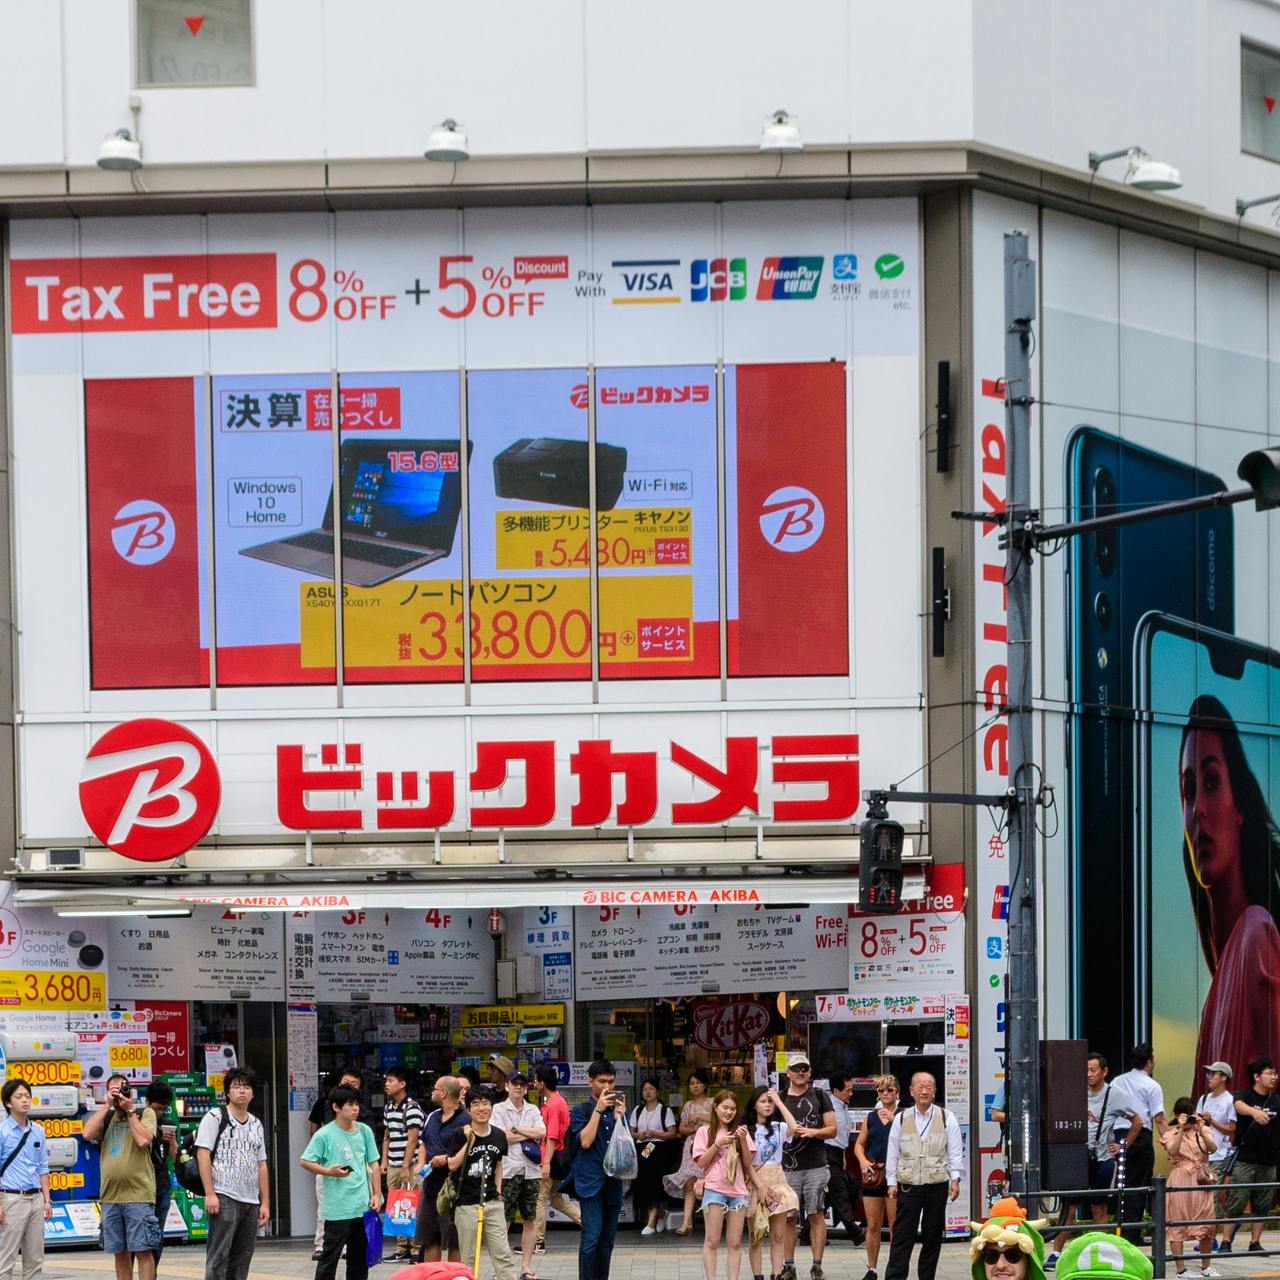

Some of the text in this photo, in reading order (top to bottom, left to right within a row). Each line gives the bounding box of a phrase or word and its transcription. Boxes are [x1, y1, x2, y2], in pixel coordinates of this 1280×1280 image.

[515, 261, 567, 276] Discount
[762, 264, 821, 282] UnionPay
[577, 269, 604, 286] Pay
[622, 271, 674, 293] VISA
[691, 270, 748, 290] JCB
[24, 272, 262, 322] Tax Free
[288, 259, 327, 323] 8
[332, 294, 398, 322] OFF
[437, 256, 476, 319] 5
[480, 291, 545, 318] OFF
[574, 283, 607, 299] With
[599, 384, 711, 406] ビックカメラ
[225, 392, 303, 429] 決算
[387, 450, 459, 473] 15.6型
[233, 481, 297, 494] Windows
[628, 479, 667, 493] Wi-Fi
[256, 496, 276, 510] 10
[245, 510, 287, 523] Home
[399, 583, 558, 606] ノートパソコン
[641, 624, 685, 637] ポイント
[640, 638, 686, 652] サービス
[276, 733, 861, 832] ビックカメラ
[299, 895, 351, 907] AKIBA
[600, 889, 760, 903] BIC CAMERA AKIBA
[424, 907, 452, 929] 4F
[815, 915, 843, 930] Free
[119, 929, 170, 939] くすり 日用品
[815, 931, 847, 949] Wi-Fi
[21, 939, 66, 957] Google
[21, 958, 70, 968] Home Mini
[1054, 1120, 1083, 1130] 103-17
[1089, 1246, 1113, 1269] L
